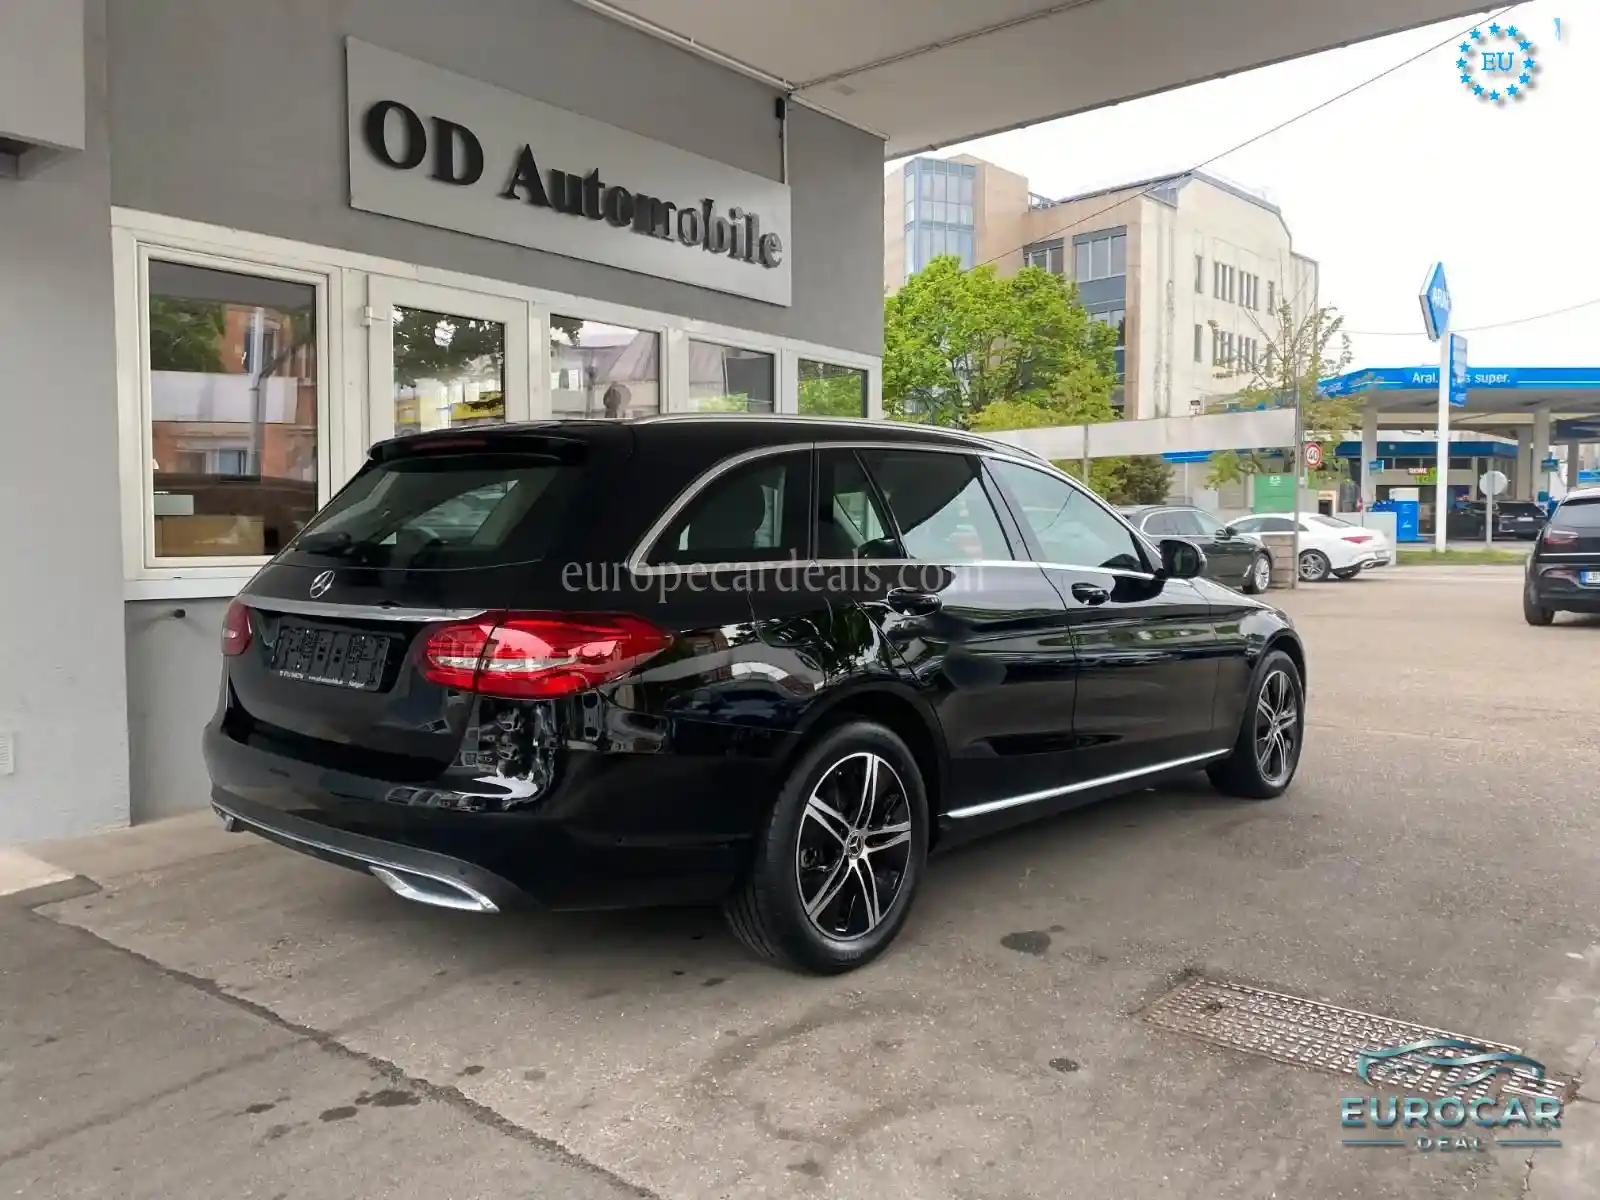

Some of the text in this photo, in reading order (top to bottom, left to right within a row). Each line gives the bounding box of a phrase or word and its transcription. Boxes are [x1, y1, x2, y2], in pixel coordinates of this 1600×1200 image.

[366, 100, 783, 268] OD Automobile
[1475, 372, 1511, 386] super.
